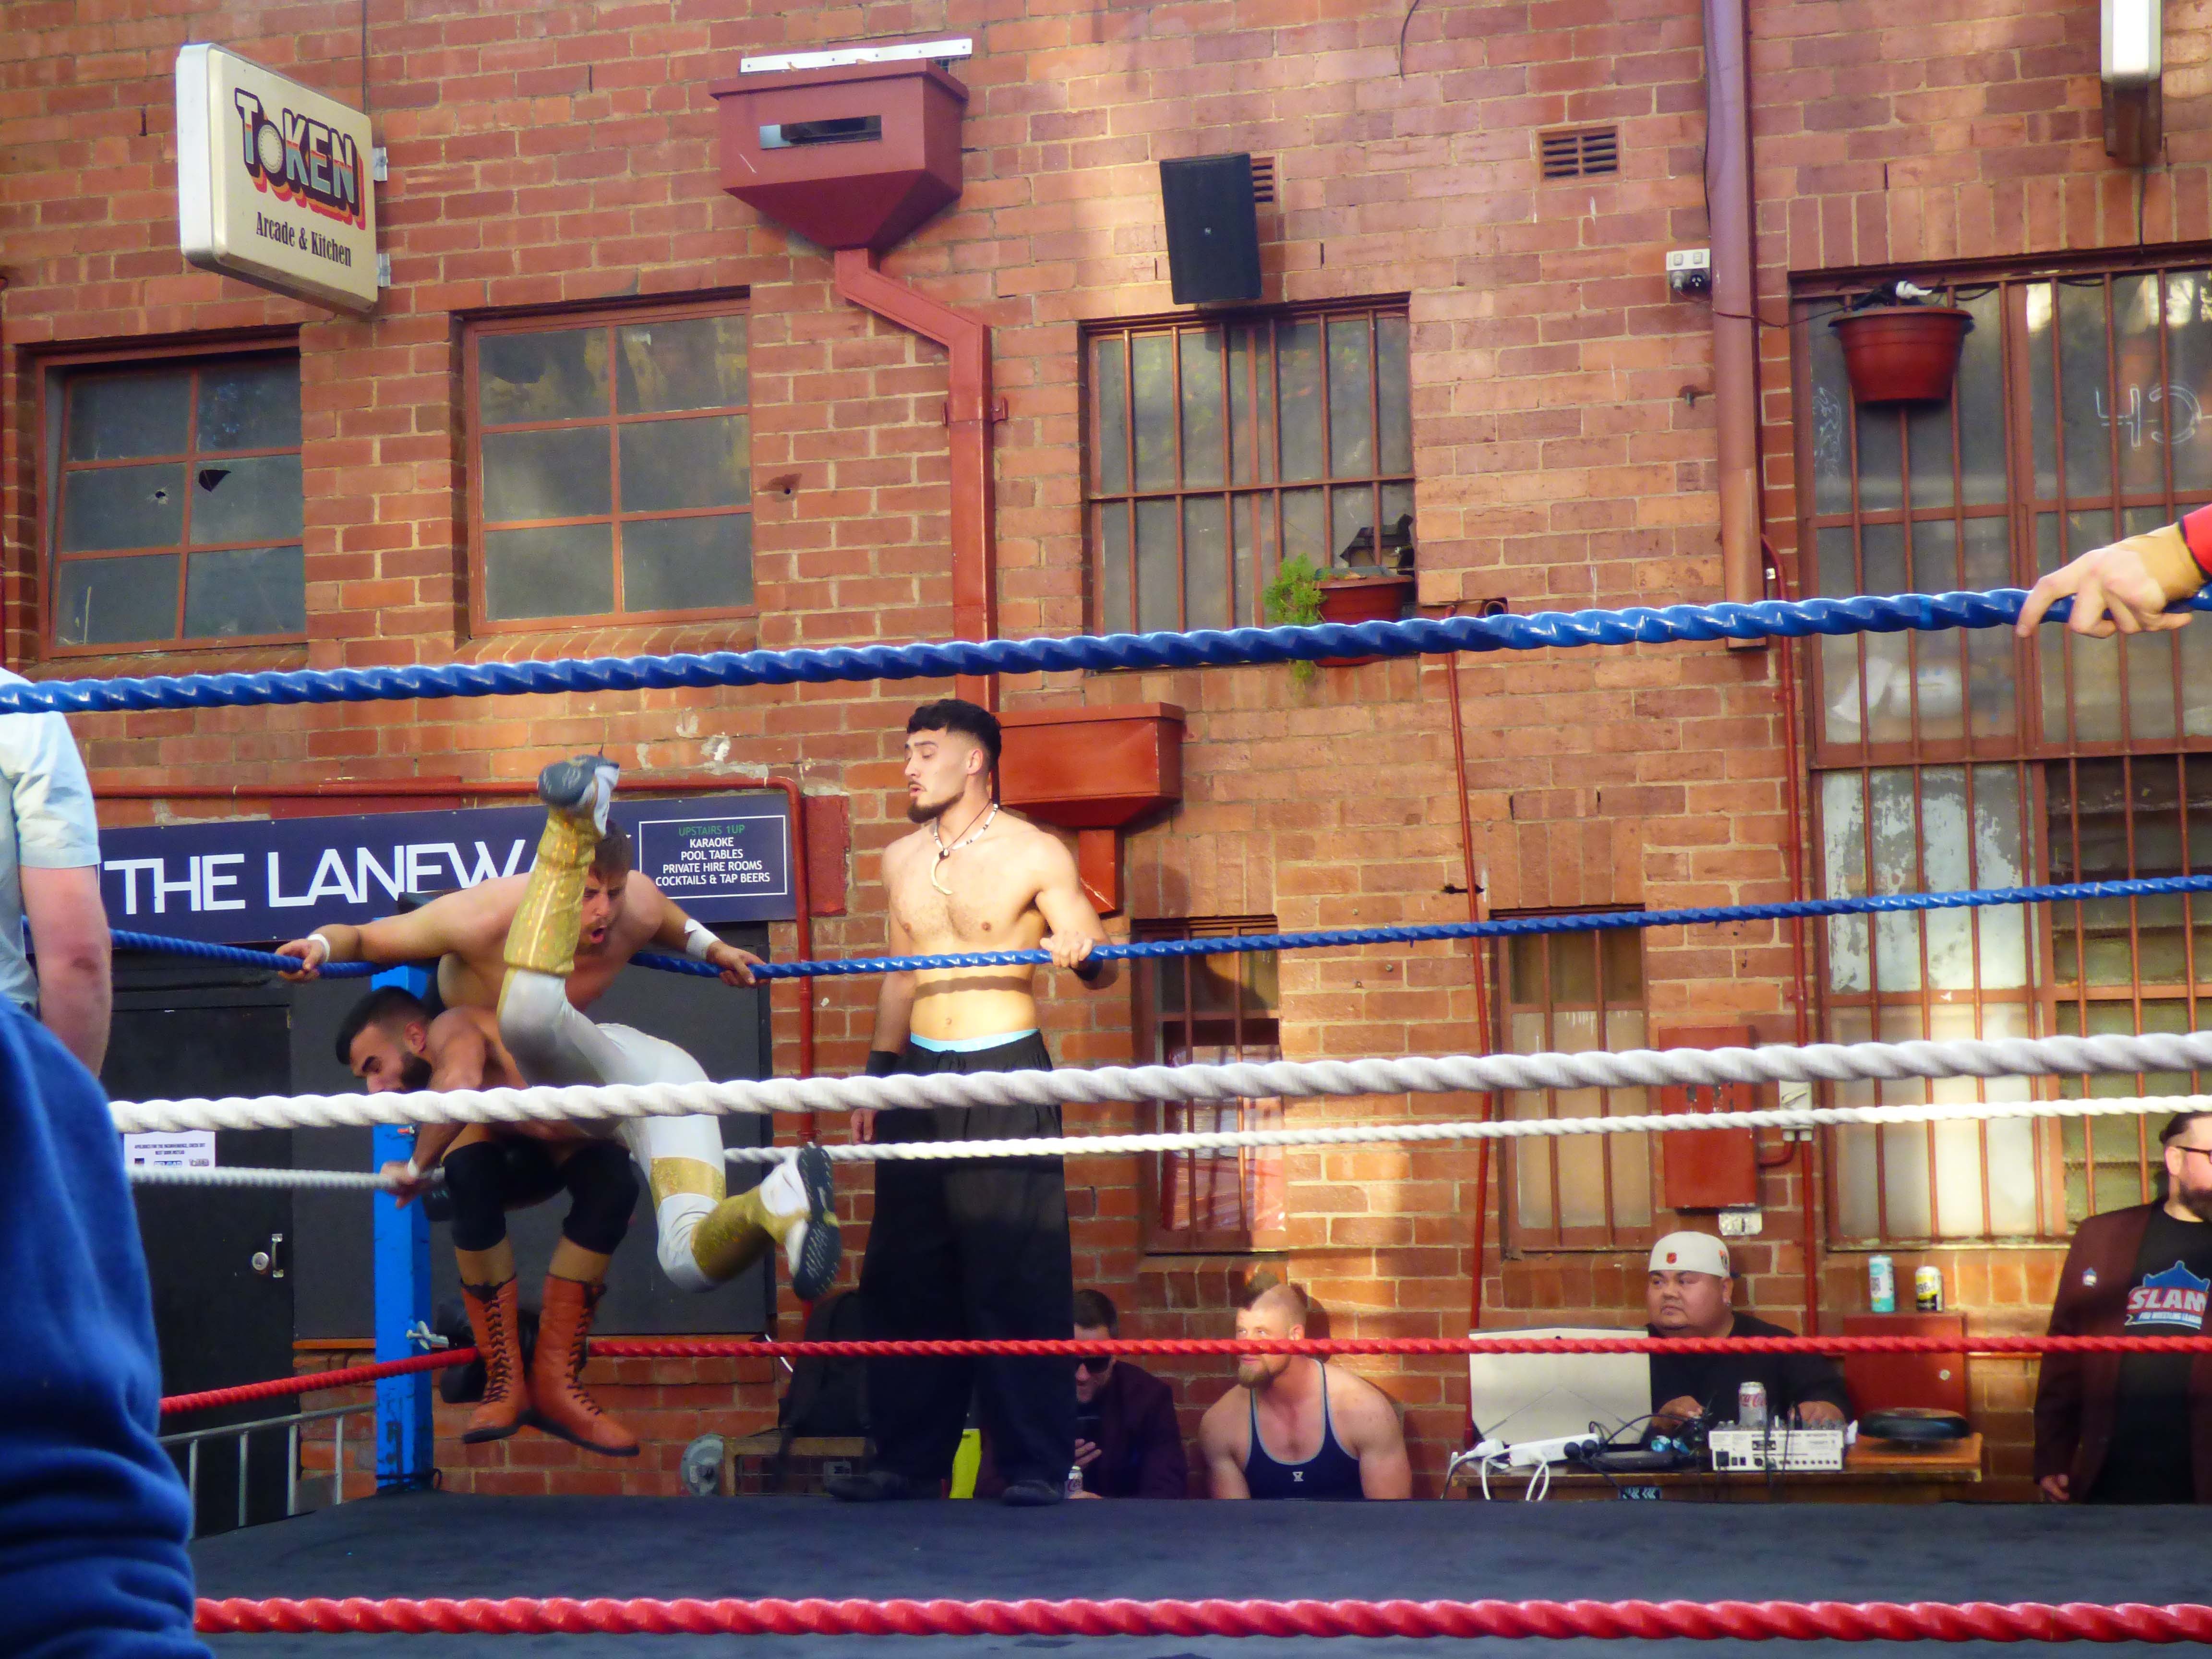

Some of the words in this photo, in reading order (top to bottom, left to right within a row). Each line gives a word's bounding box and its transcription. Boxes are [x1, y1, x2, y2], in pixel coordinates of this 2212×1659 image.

[235, 87, 364, 224] TOKEN
[256, 211, 295, 247] Arcade
[299, 228, 308, 251] &
[311, 231, 352, 267] Kitchen
[678, 825, 722, 836] UPSTAIRS
[726, 824, 745, 835] 1UP
[689, 837, 734, 848] KARAOKE
[681, 850, 707, 861] POOL
[709, 849, 744, 860] TABLES
[104, 853, 246, 914] THE
[268, 834, 632, 907] LANEW
[662, 863, 700, 874] PRIVATE
[703, 862, 725, 872] HIRE
[728, 860, 763, 871] ROOMS
[655, 874, 707, 887] COCKTAILS
[709, 874, 717, 884] &
[719, 873, 738, 883] TAP
[740, 872, 770, 883] BEERS
[2127, 1288, 2207, 1312] SLAM
